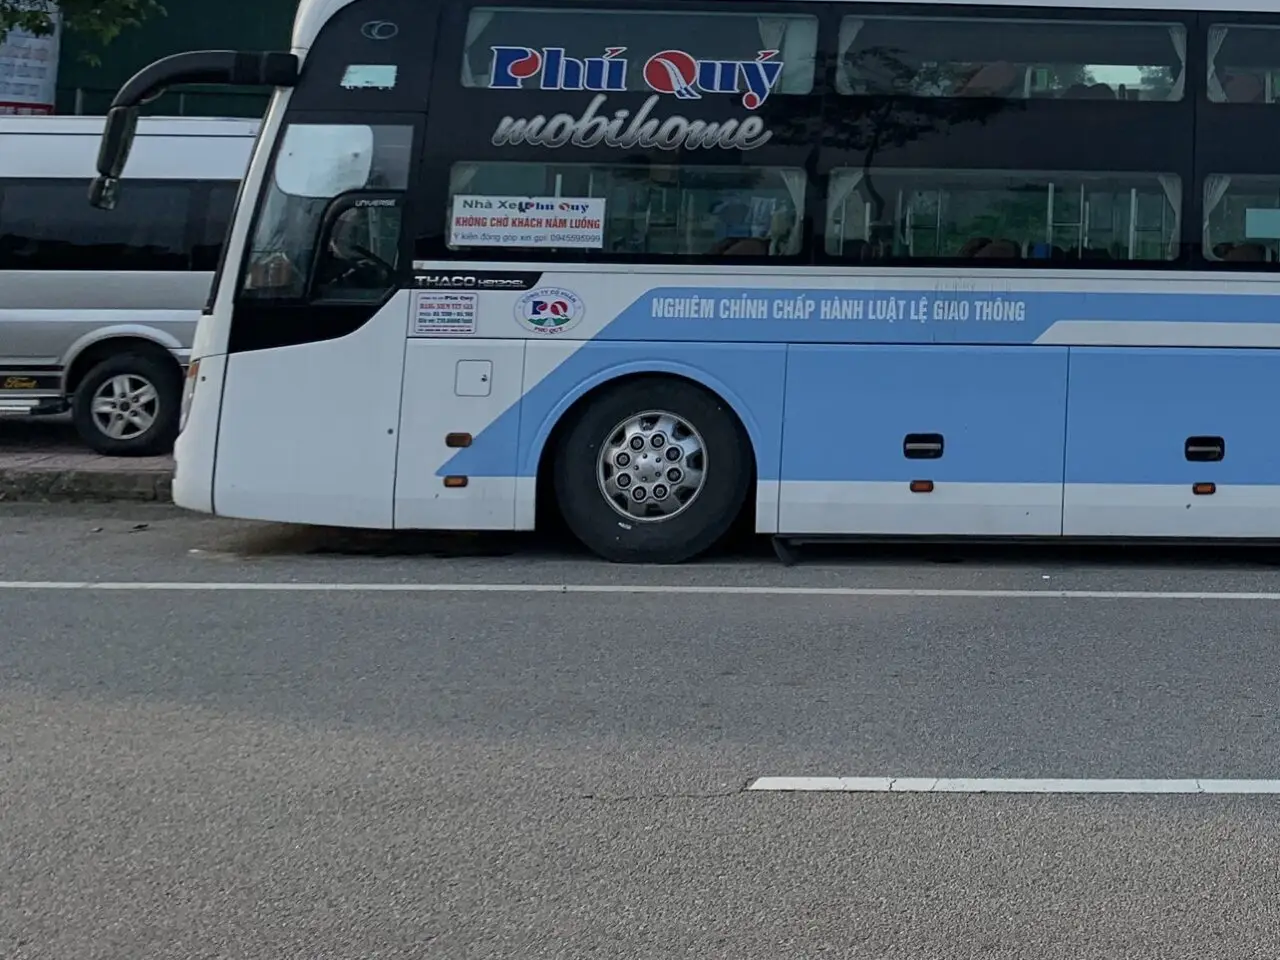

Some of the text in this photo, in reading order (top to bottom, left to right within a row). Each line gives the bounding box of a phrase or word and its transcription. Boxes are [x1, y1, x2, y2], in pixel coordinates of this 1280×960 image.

[488, 46, 783, 109] Phú Quý
[491, 93, 774, 151] mobihome
[462, 200, 493, 209] Nhà
[455, 214, 488, 227] KHÔNG
[414, 276, 476, 287] THACO
[652, 295, 714, 318] NGHIÊM
[772, 294, 815, 320] CHẤP
[820, 296, 863, 320] HÀNH
[867, 297, 906, 323] LUẬT
[910, 297, 928, 324] LỆ
[933, 300, 970, 322] GIAO
[974, 298, 1025, 322] THÔNG
